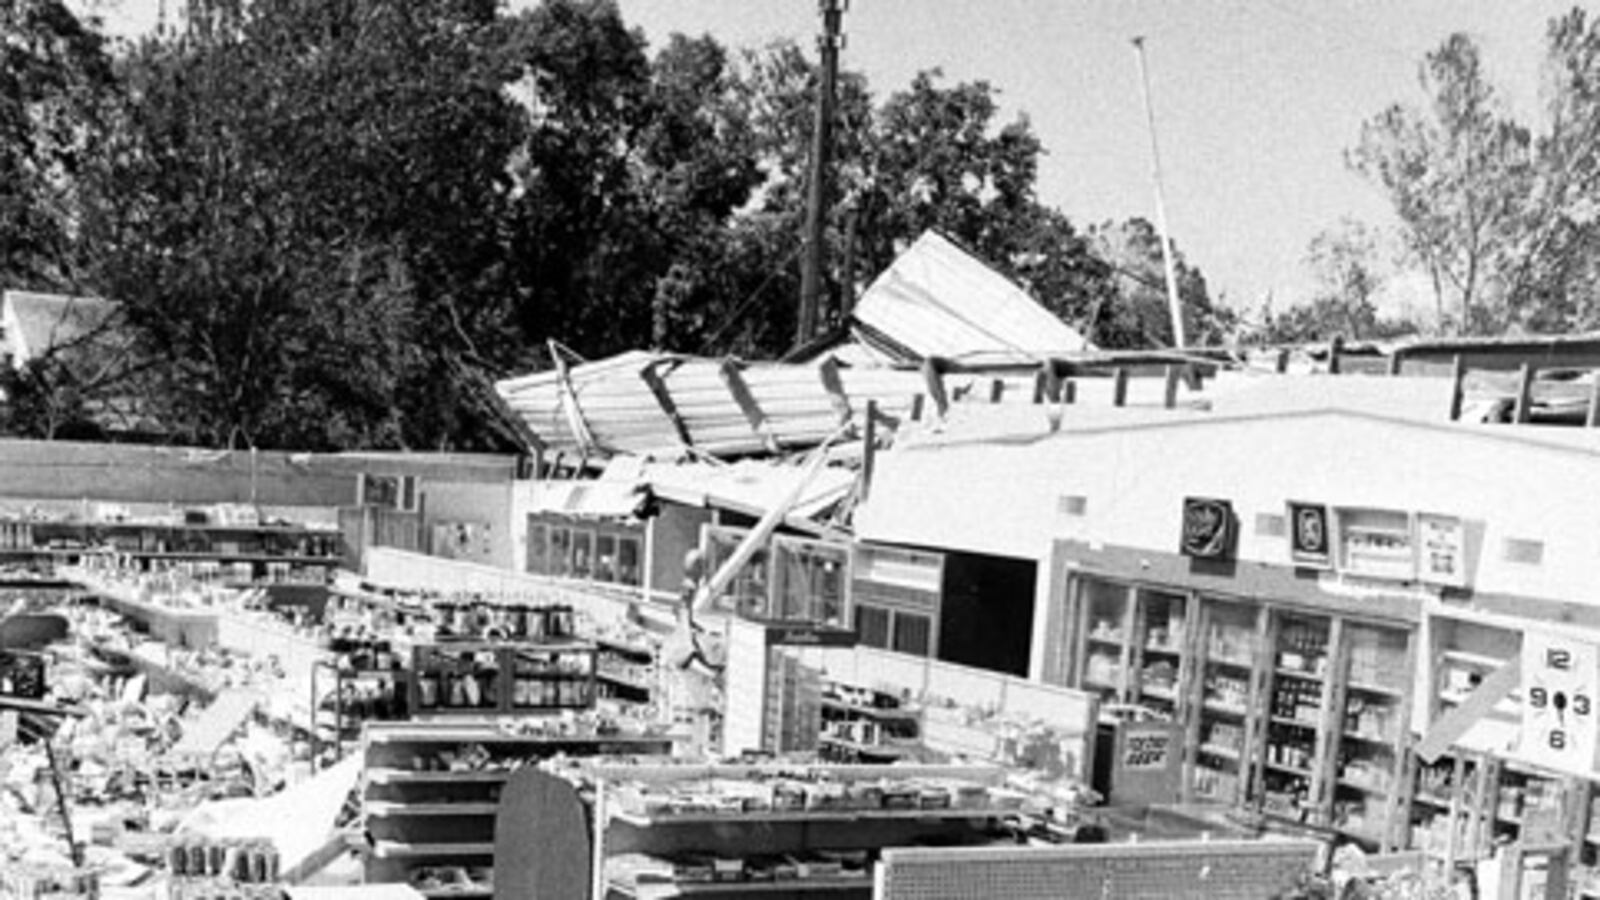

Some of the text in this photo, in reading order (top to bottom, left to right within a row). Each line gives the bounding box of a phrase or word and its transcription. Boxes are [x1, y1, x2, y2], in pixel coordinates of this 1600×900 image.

[1546, 648, 1570, 670] 12
[1529, 687, 1548, 708] 9
[1572, 694, 1591, 715] 3
[1549, 729, 1565, 749] 6
